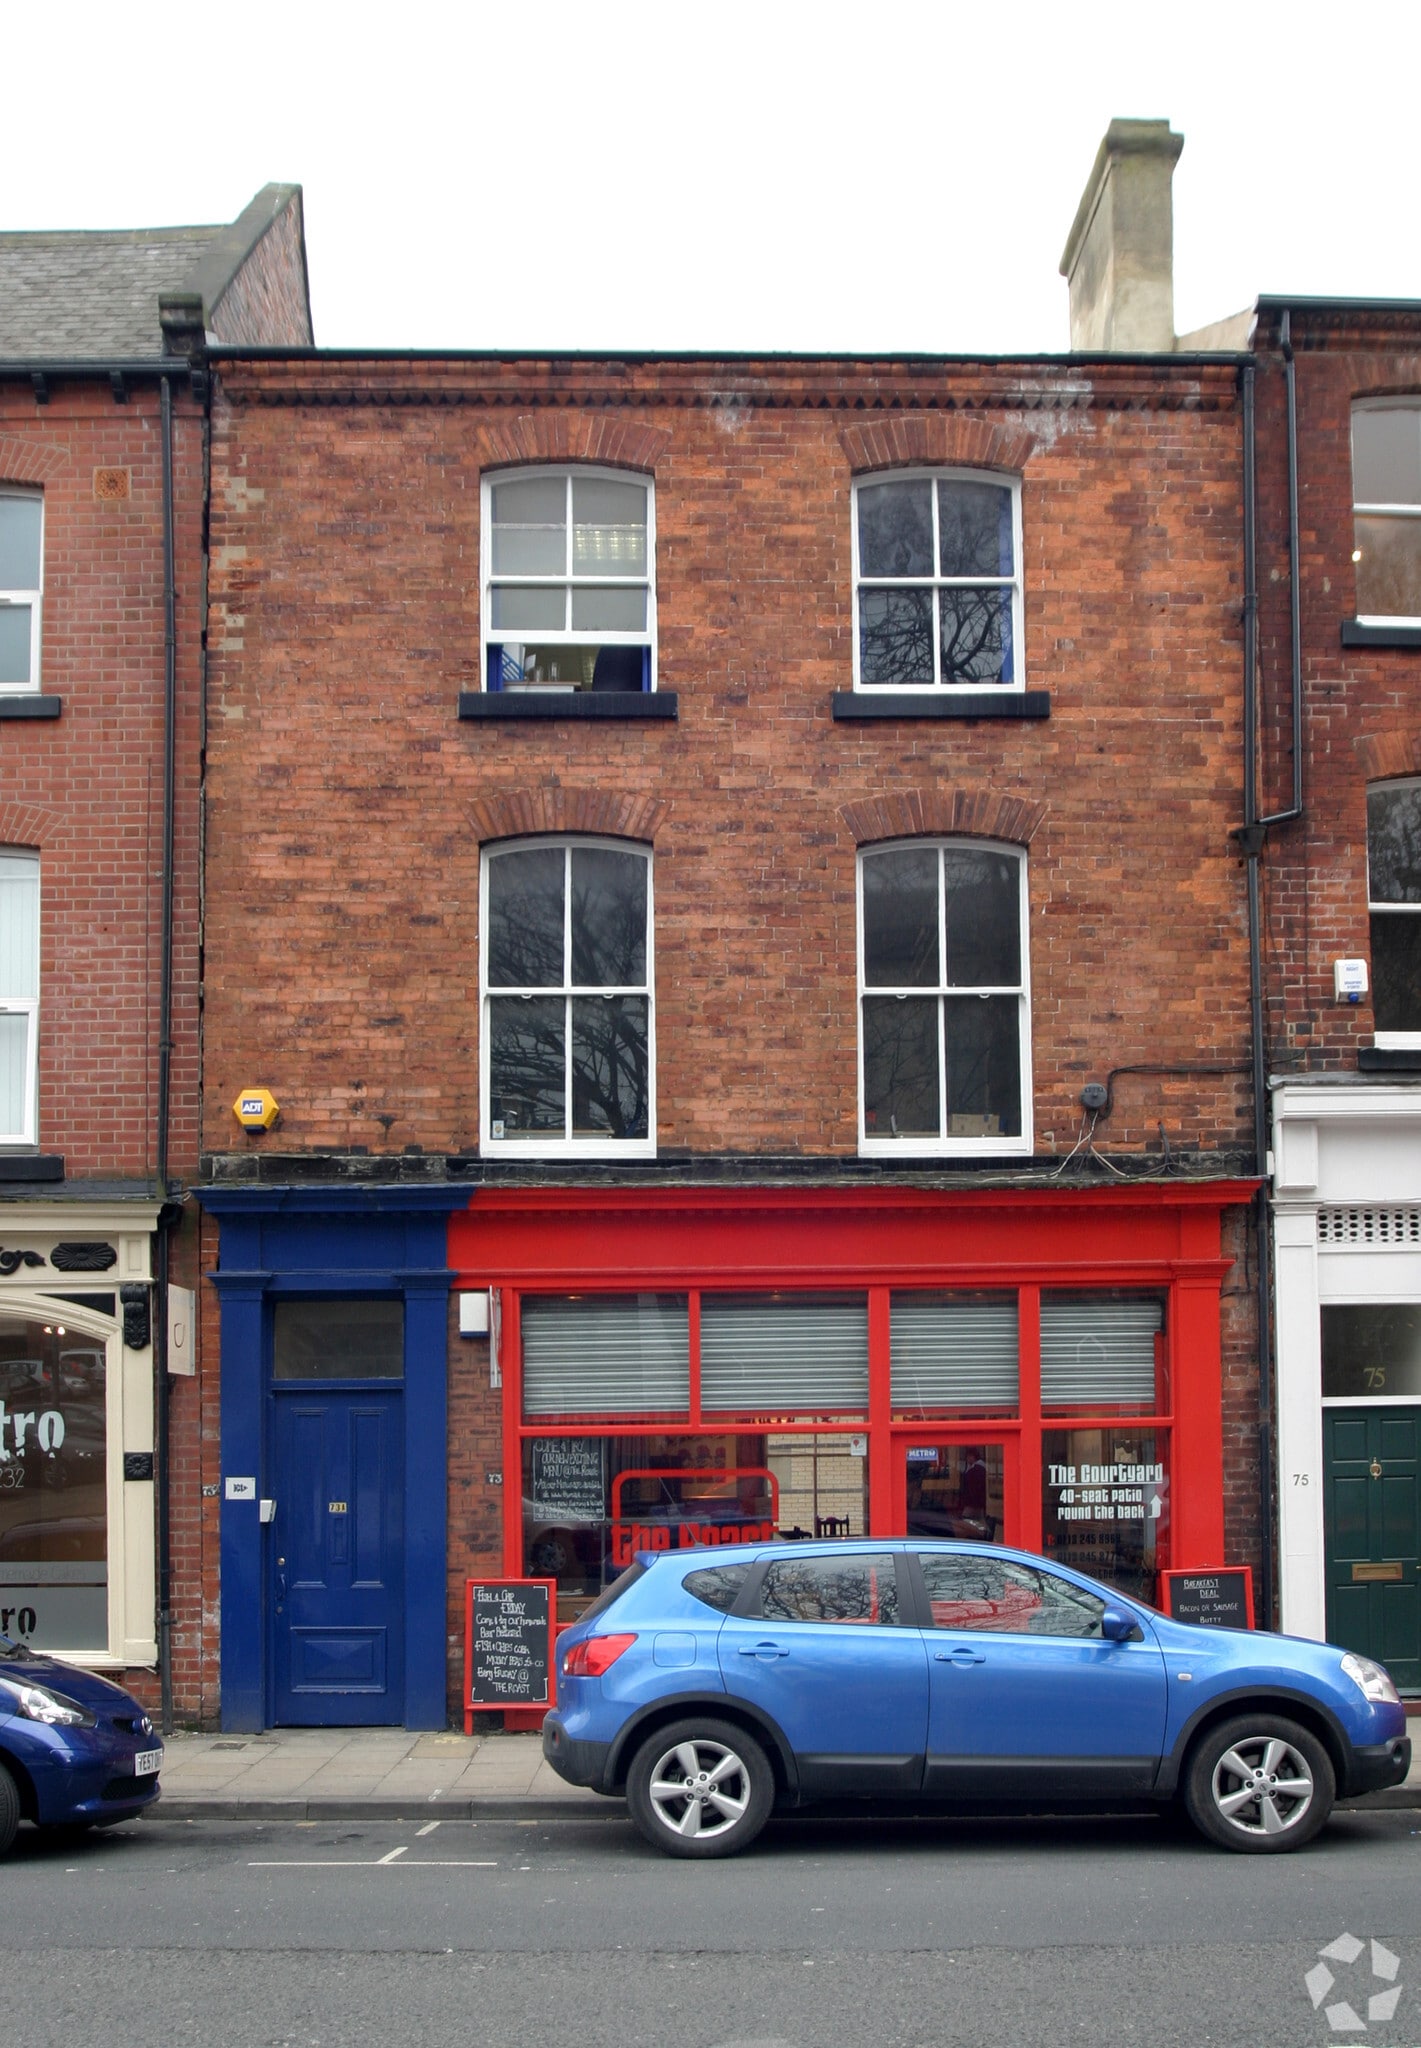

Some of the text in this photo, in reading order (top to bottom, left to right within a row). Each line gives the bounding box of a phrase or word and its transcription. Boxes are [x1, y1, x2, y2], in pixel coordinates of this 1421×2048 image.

[242, 1102, 264, 1113] ADT
[1363, 1367, 1387, 1388] 75
[908, 1448, 936, 1458] METRO
[0, 1467, 25, 1488] 32
[488, 1473, 503, 1484] 73
[1048, 1463, 1163, 1483] The Courtyard
[1293, 1474, 1309, 1486] 75
[1059, 1488, 1143, 1504] 40-seat patio
[1057, 1504, 1145, 1520] round the back
[1057, 1534, 1077, 1545] 0113
[1079, 1533, 1097, 1545] 245
[1183, 1578, 1219, 1589] BREAKFAST
[1199, 1589, 1219, 1598] DEAL
[1179, 1604, 1200, 1612] BACON
[1213, 1602, 1239, 1611] SAUSAGE
[507, 1682, 530, 1694] ROAST
